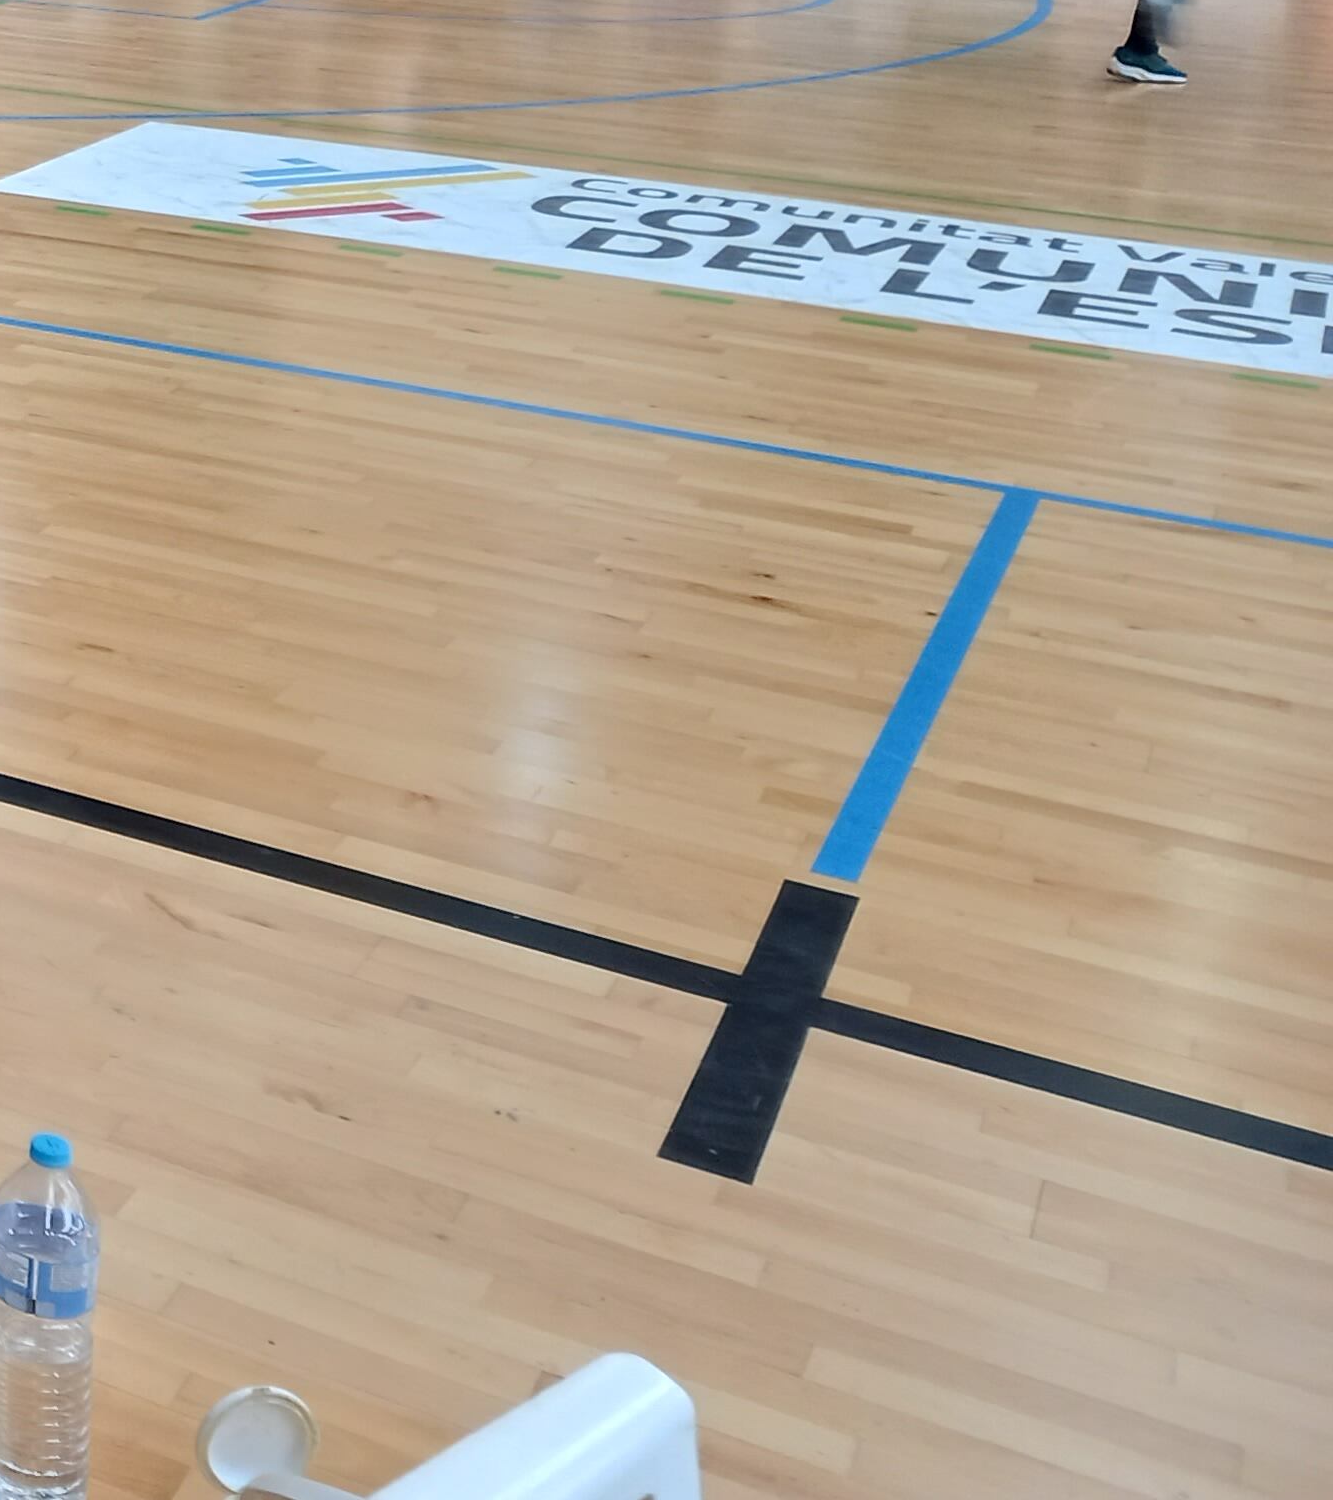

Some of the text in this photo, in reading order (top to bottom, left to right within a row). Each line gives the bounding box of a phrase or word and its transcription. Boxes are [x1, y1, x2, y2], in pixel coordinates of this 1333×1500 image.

[571, 178, 1085, 254] Comunitat
[565, 227, 1333, 354] DE L'ES
